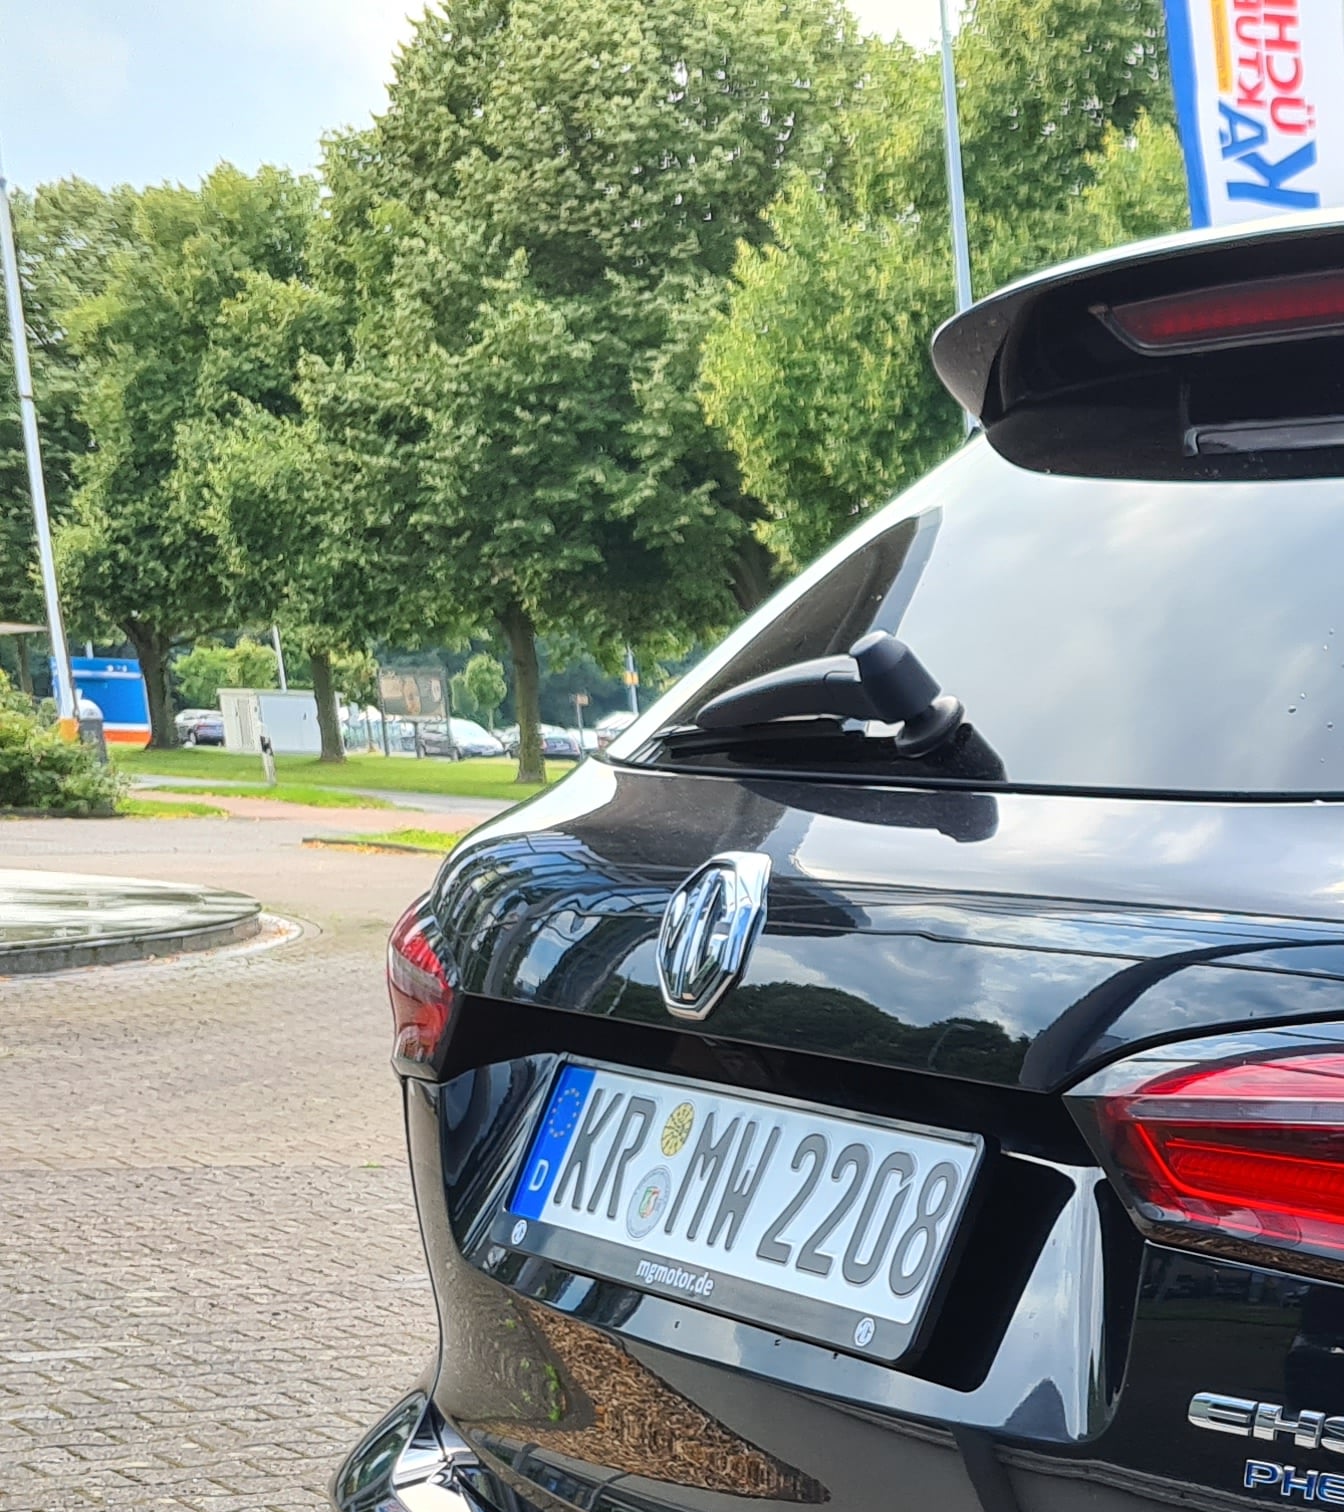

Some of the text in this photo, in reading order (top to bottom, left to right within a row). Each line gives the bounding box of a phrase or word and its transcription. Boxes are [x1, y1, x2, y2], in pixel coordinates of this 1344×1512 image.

[527, 1158, 551, 1192] D
[553, 1087, 961, 1297] KR MW 2208
[635, 1259, 714, 1296] mgmotor.de
